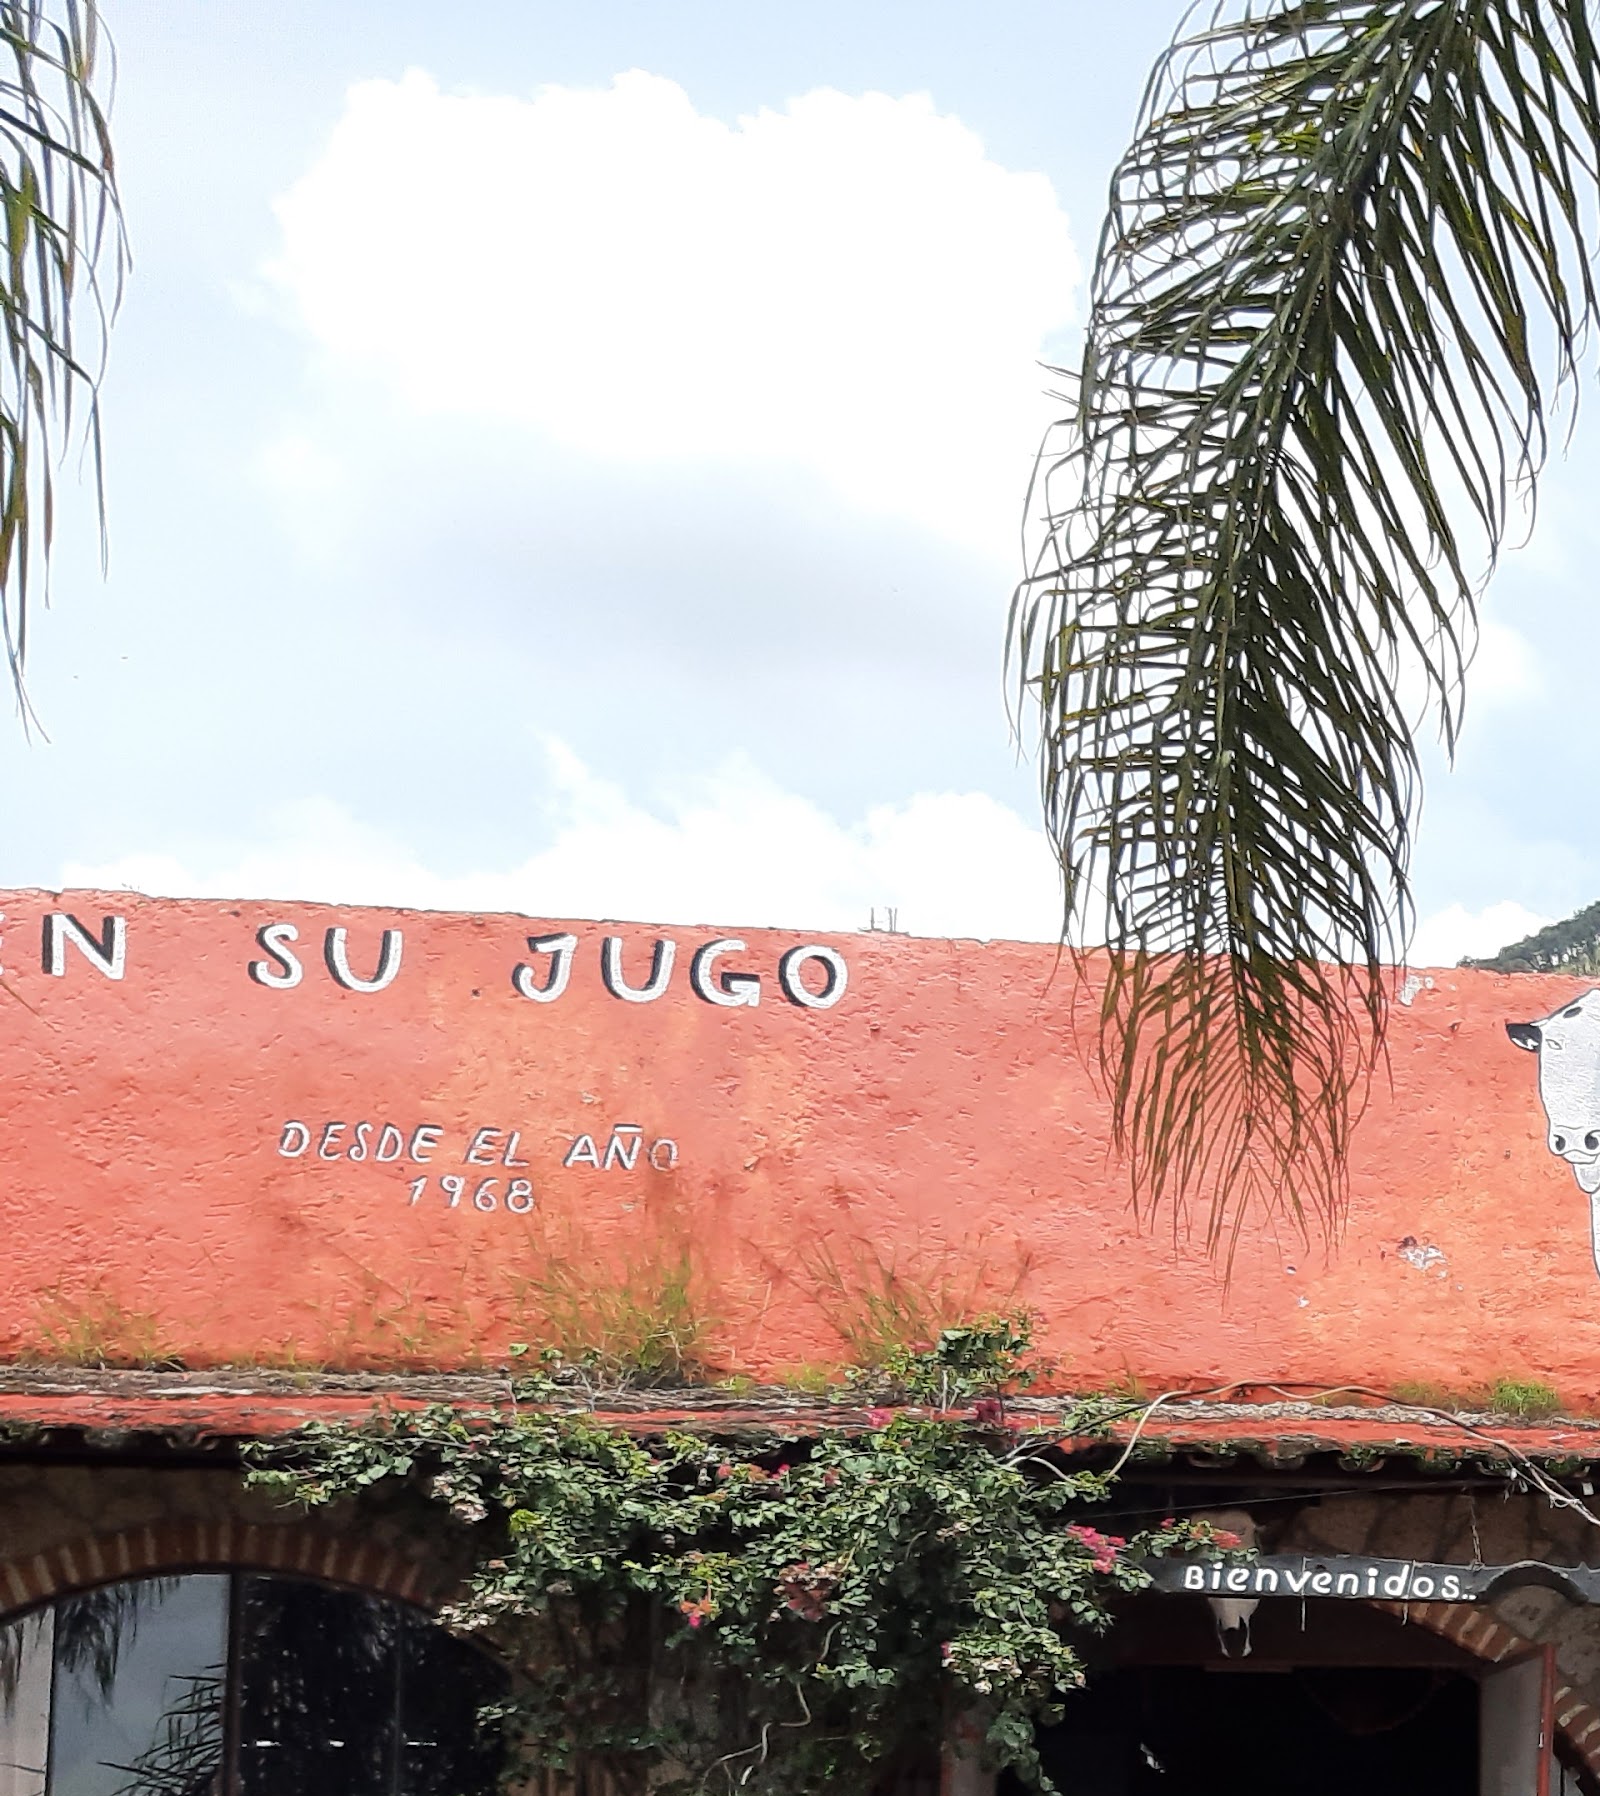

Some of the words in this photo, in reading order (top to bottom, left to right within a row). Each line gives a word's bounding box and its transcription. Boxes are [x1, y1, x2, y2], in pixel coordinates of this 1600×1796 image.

[248, 923, 403, 993] SU
[511, 932, 848, 1009] JUGO
[277, 1120, 444, 1163] DESDE
[465, 1126, 530, 1168] EL
[562, 1123, 680, 1172] AÑO
[408, 1174, 535, 1215] 1968
